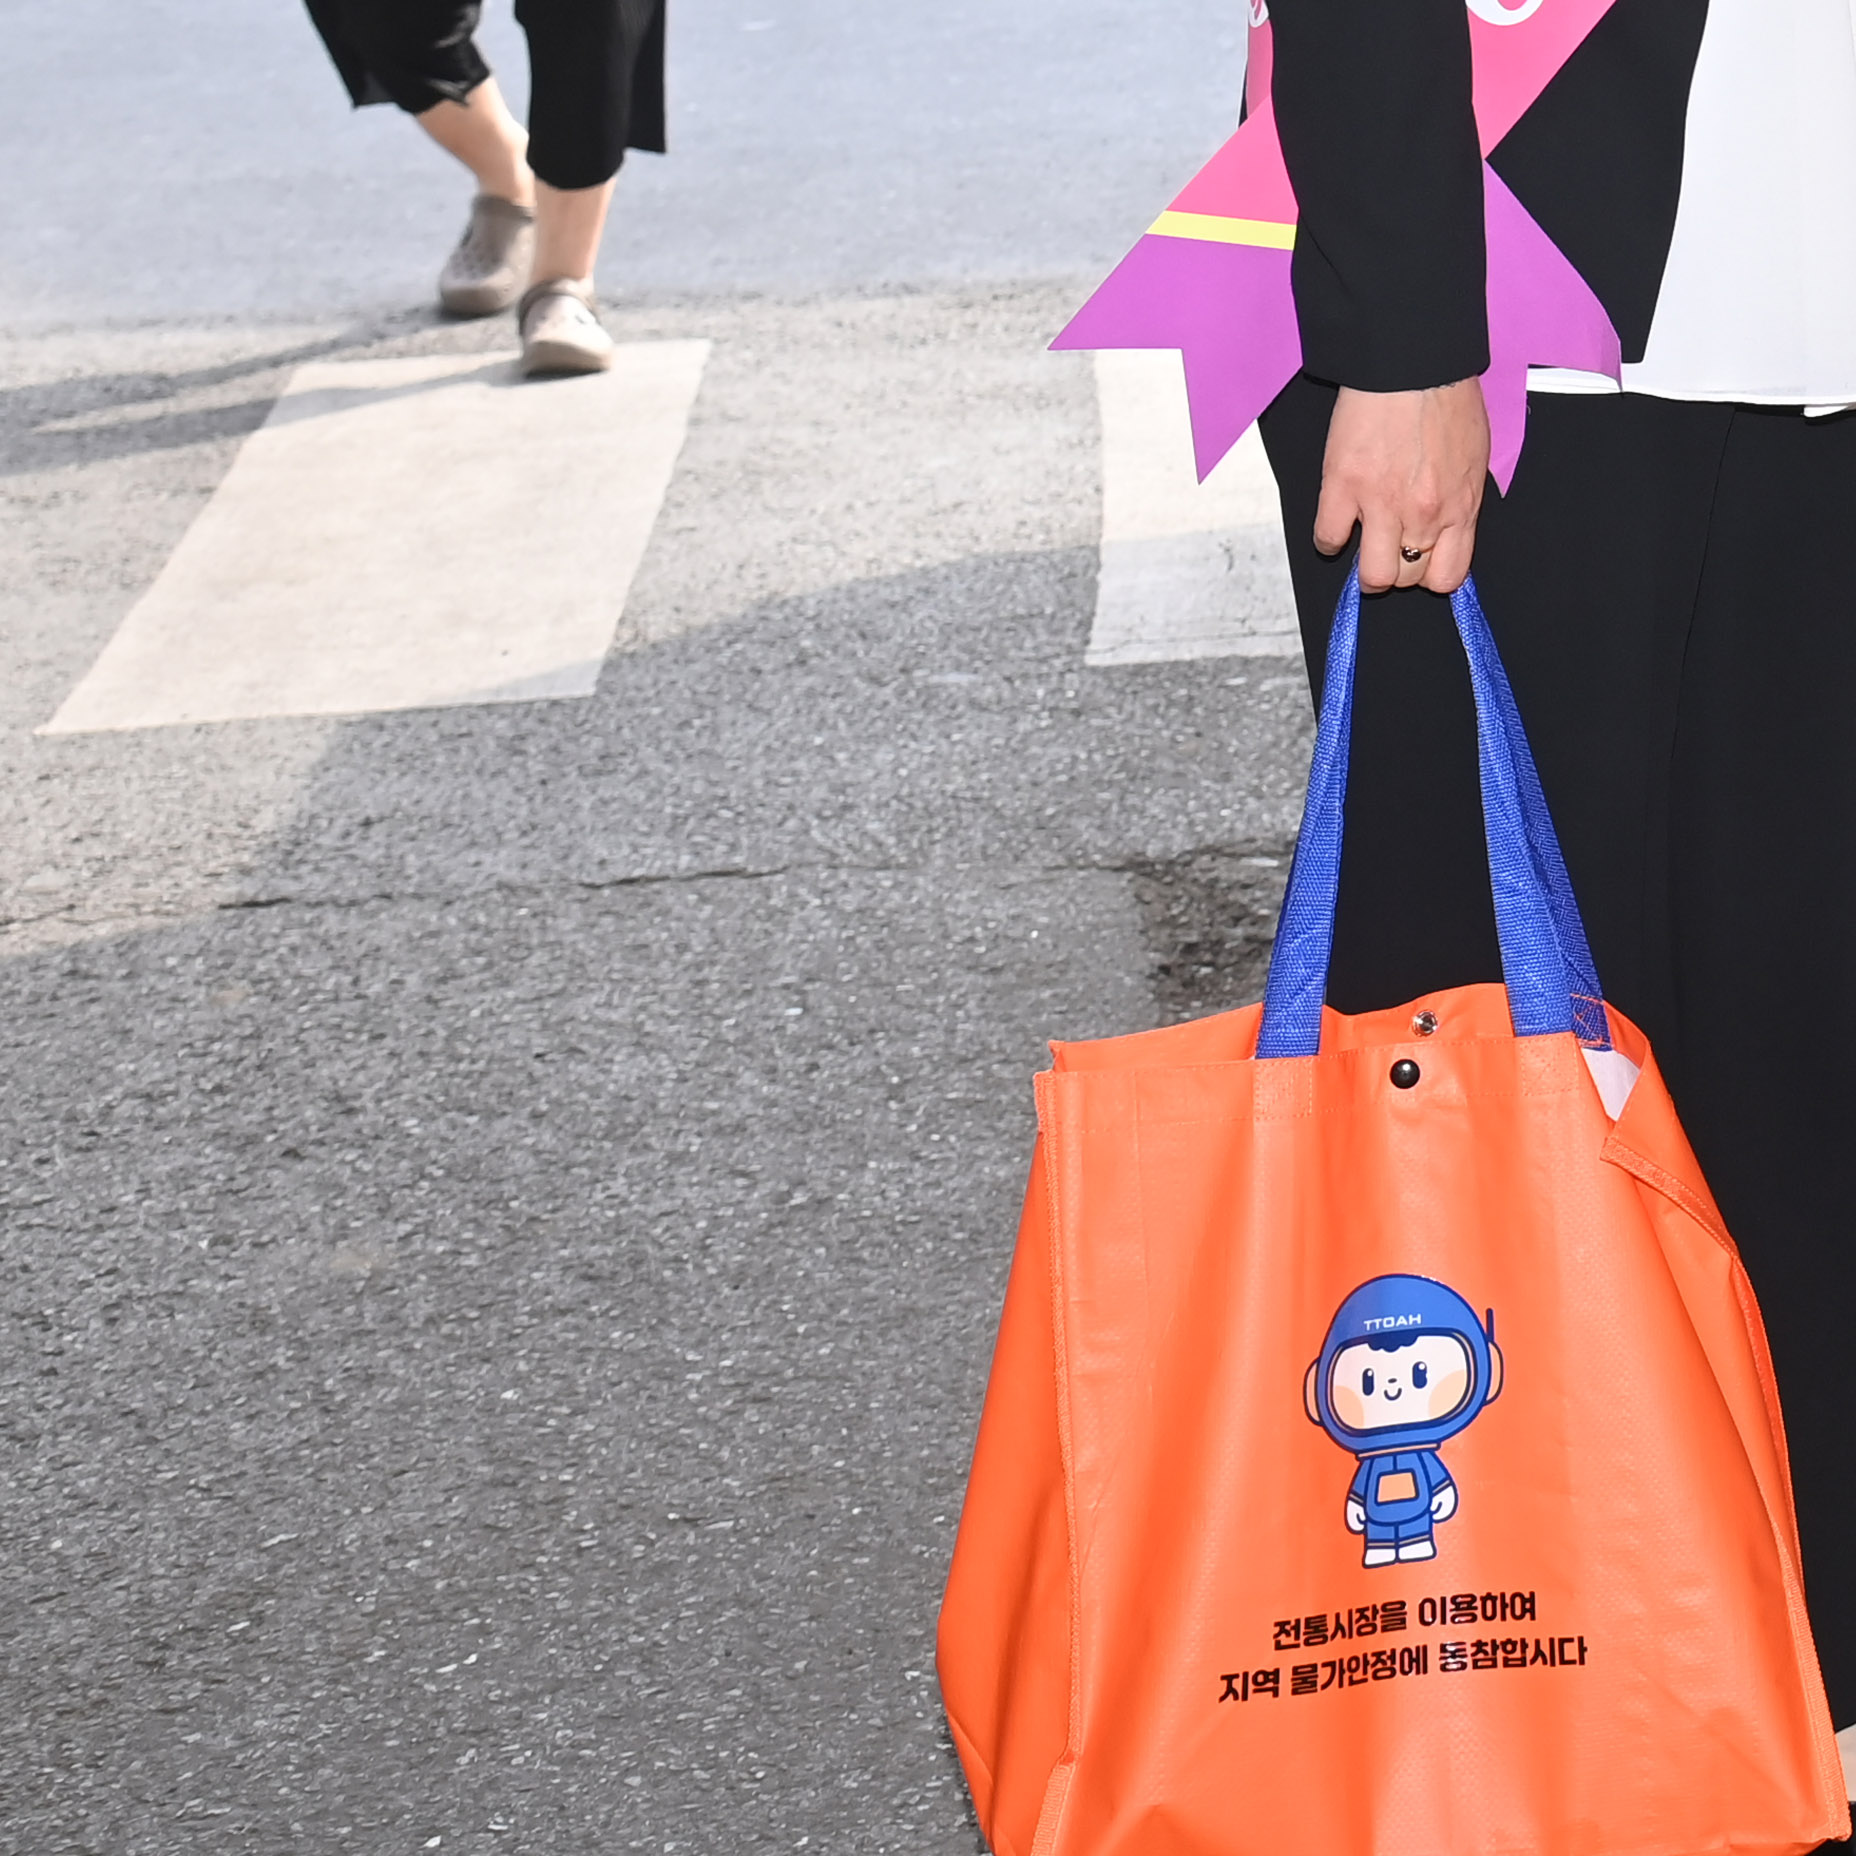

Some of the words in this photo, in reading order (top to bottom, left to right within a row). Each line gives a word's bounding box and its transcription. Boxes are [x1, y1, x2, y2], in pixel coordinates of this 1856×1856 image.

[1272, 1599, 1408, 1652] 전통시장을
[1417, 1590, 1538, 1628] 이용하여
[1218, 1667, 1281, 1704] 지역
[1290, 1645, 1429, 1697] 물가안정에
[1438, 1635, 1589, 1673] 동참합시다
